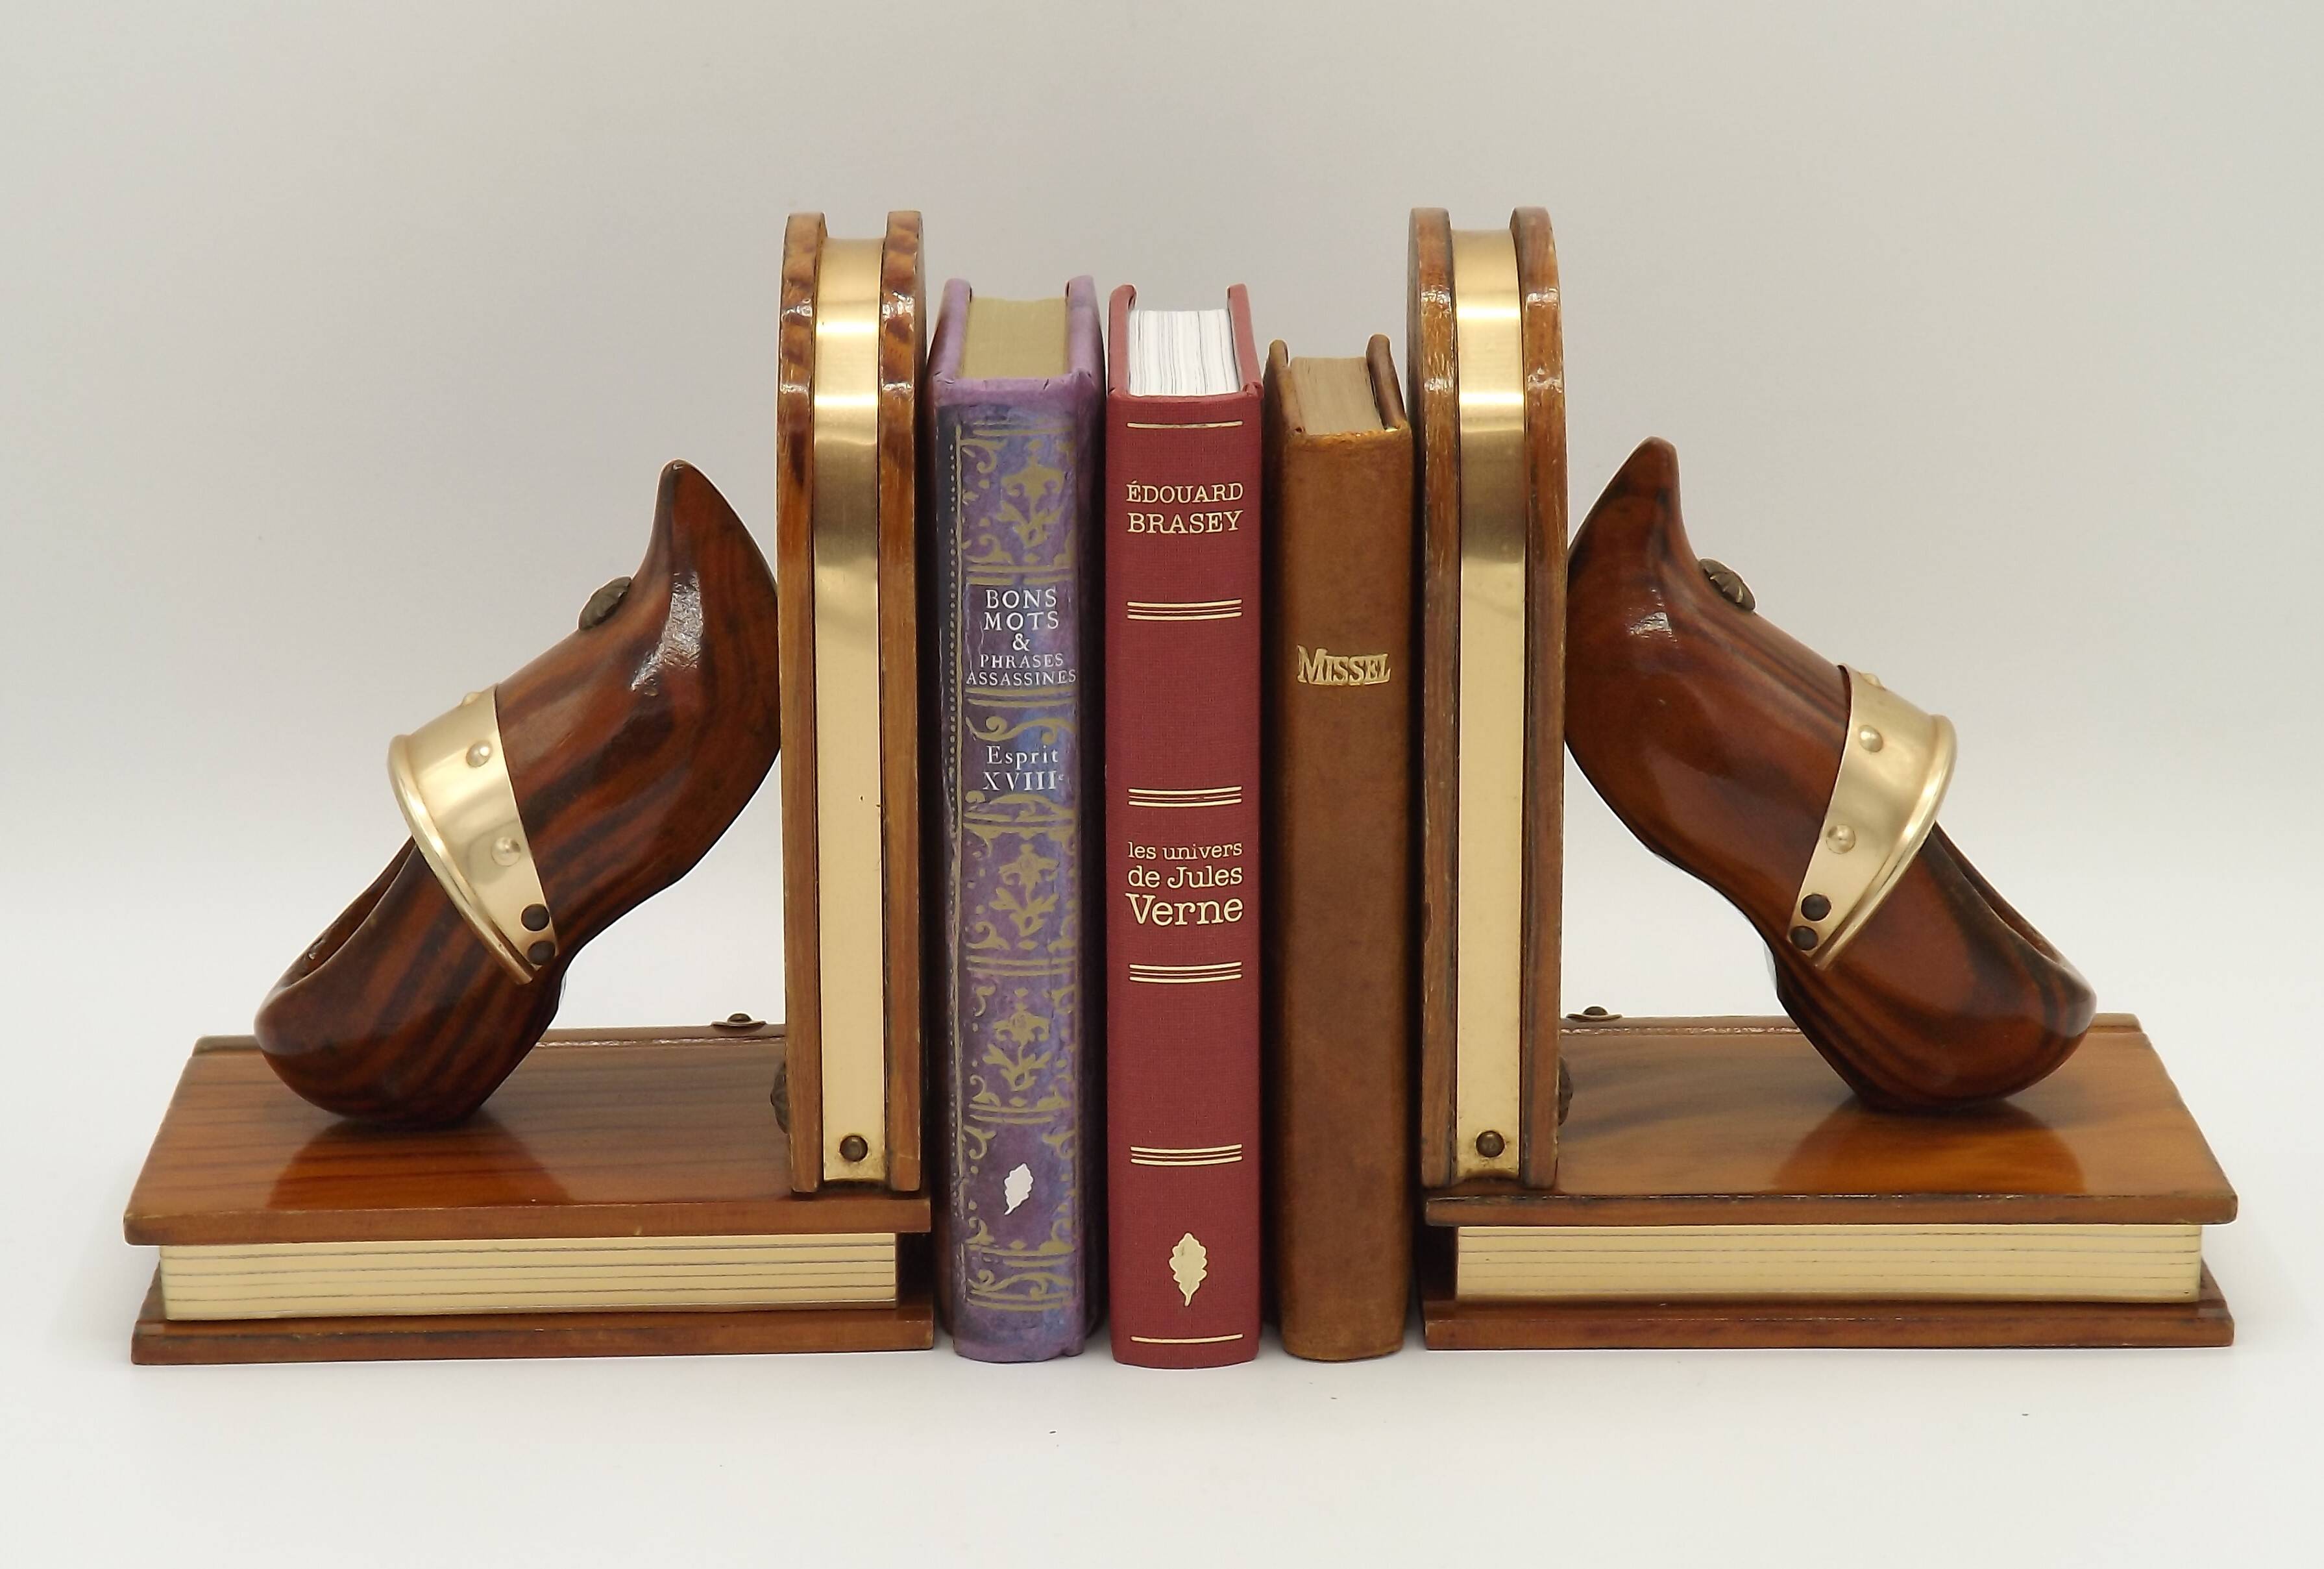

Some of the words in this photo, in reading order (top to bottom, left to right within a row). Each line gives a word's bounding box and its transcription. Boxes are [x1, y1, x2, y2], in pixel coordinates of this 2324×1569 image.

[1126, 480, 1244, 504] ÉDOUARD
[1127, 510, 1243, 534] BRASEY
[985, 587, 1057, 609] BONS
[983, 610, 1059, 631] MOTS
[1012, 632, 1030, 652] &
[979, 653, 1064, 669] PHRASES
[1297, 643, 1391, 686] MISSEL
[966, 669, 1076, 686] ASSASSINES
[986, 745, 1058, 771] Esprit
[1128, 841, 1156, 859] les
[1162, 843, 1243, 860] univers
[1128, 865, 1160, 888] de
[1167, 865, 1243, 889] Jules
[1125, 893, 1243, 926] Verne
